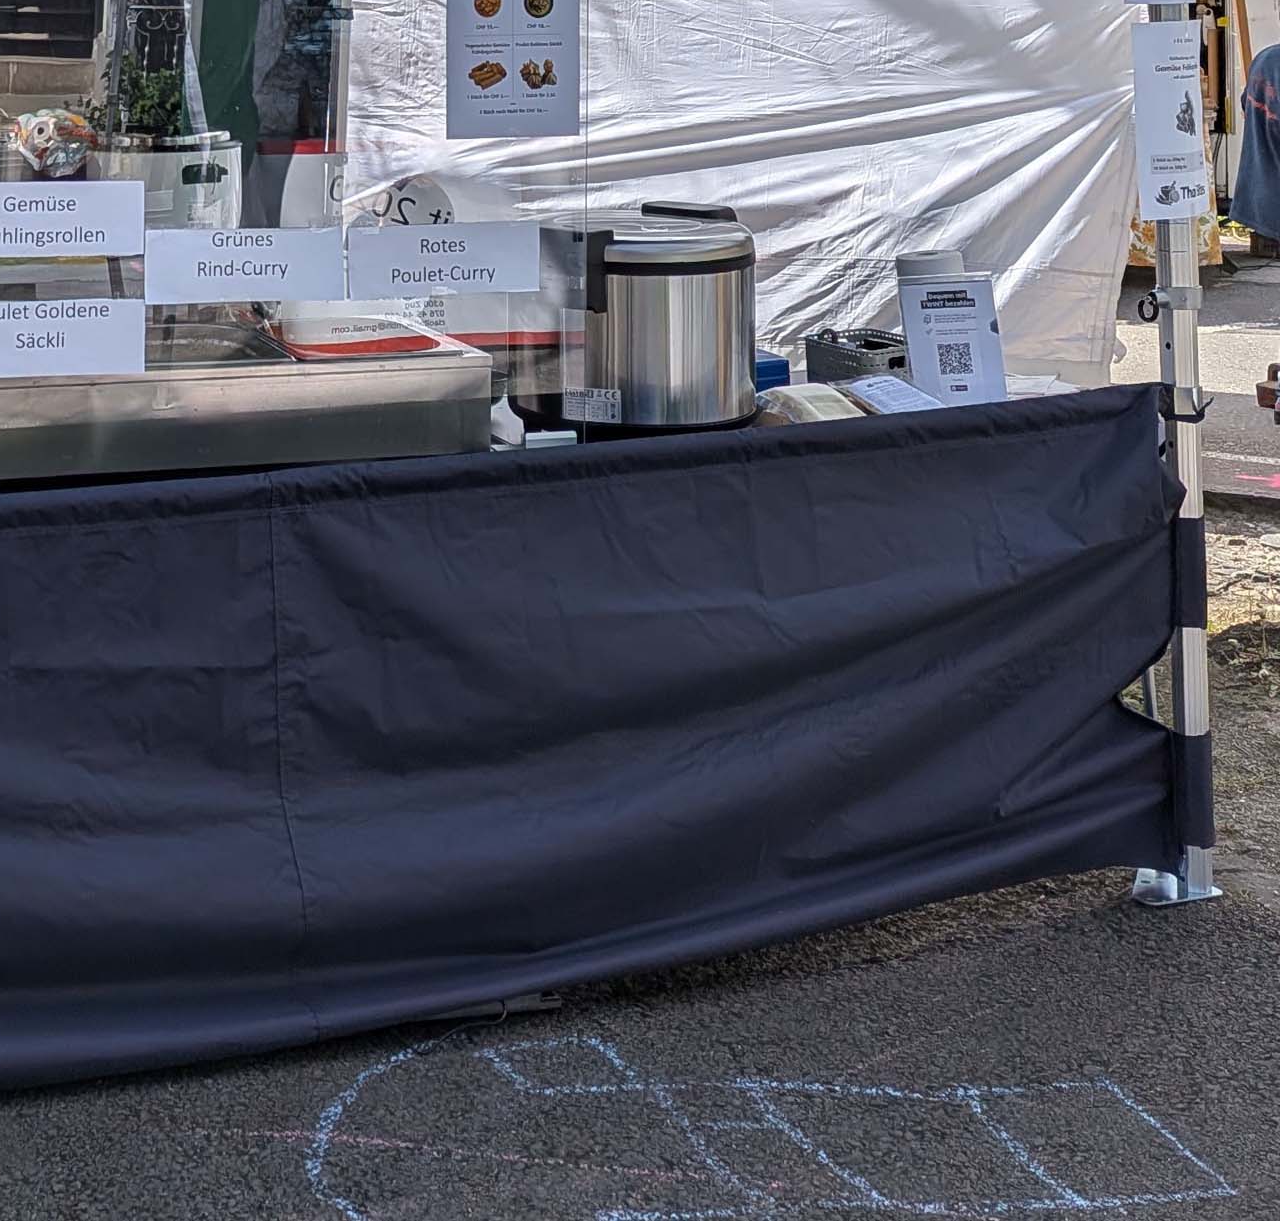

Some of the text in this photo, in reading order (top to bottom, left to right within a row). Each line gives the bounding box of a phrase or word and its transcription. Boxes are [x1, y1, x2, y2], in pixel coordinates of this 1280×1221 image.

[3, 196, 77, 212] Gemüse
[211, 231, 274, 248] Grünes
[420, 238, 466, 254] Rotes
[197, 260, 289, 279] Rind-Curry
[391, 266, 496, 284] Poulet-Curry
[34, 302, 110, 320] Goldene
[922, 300, 944, 308] TWINT
[15, 332, 65, 349] Säckli
